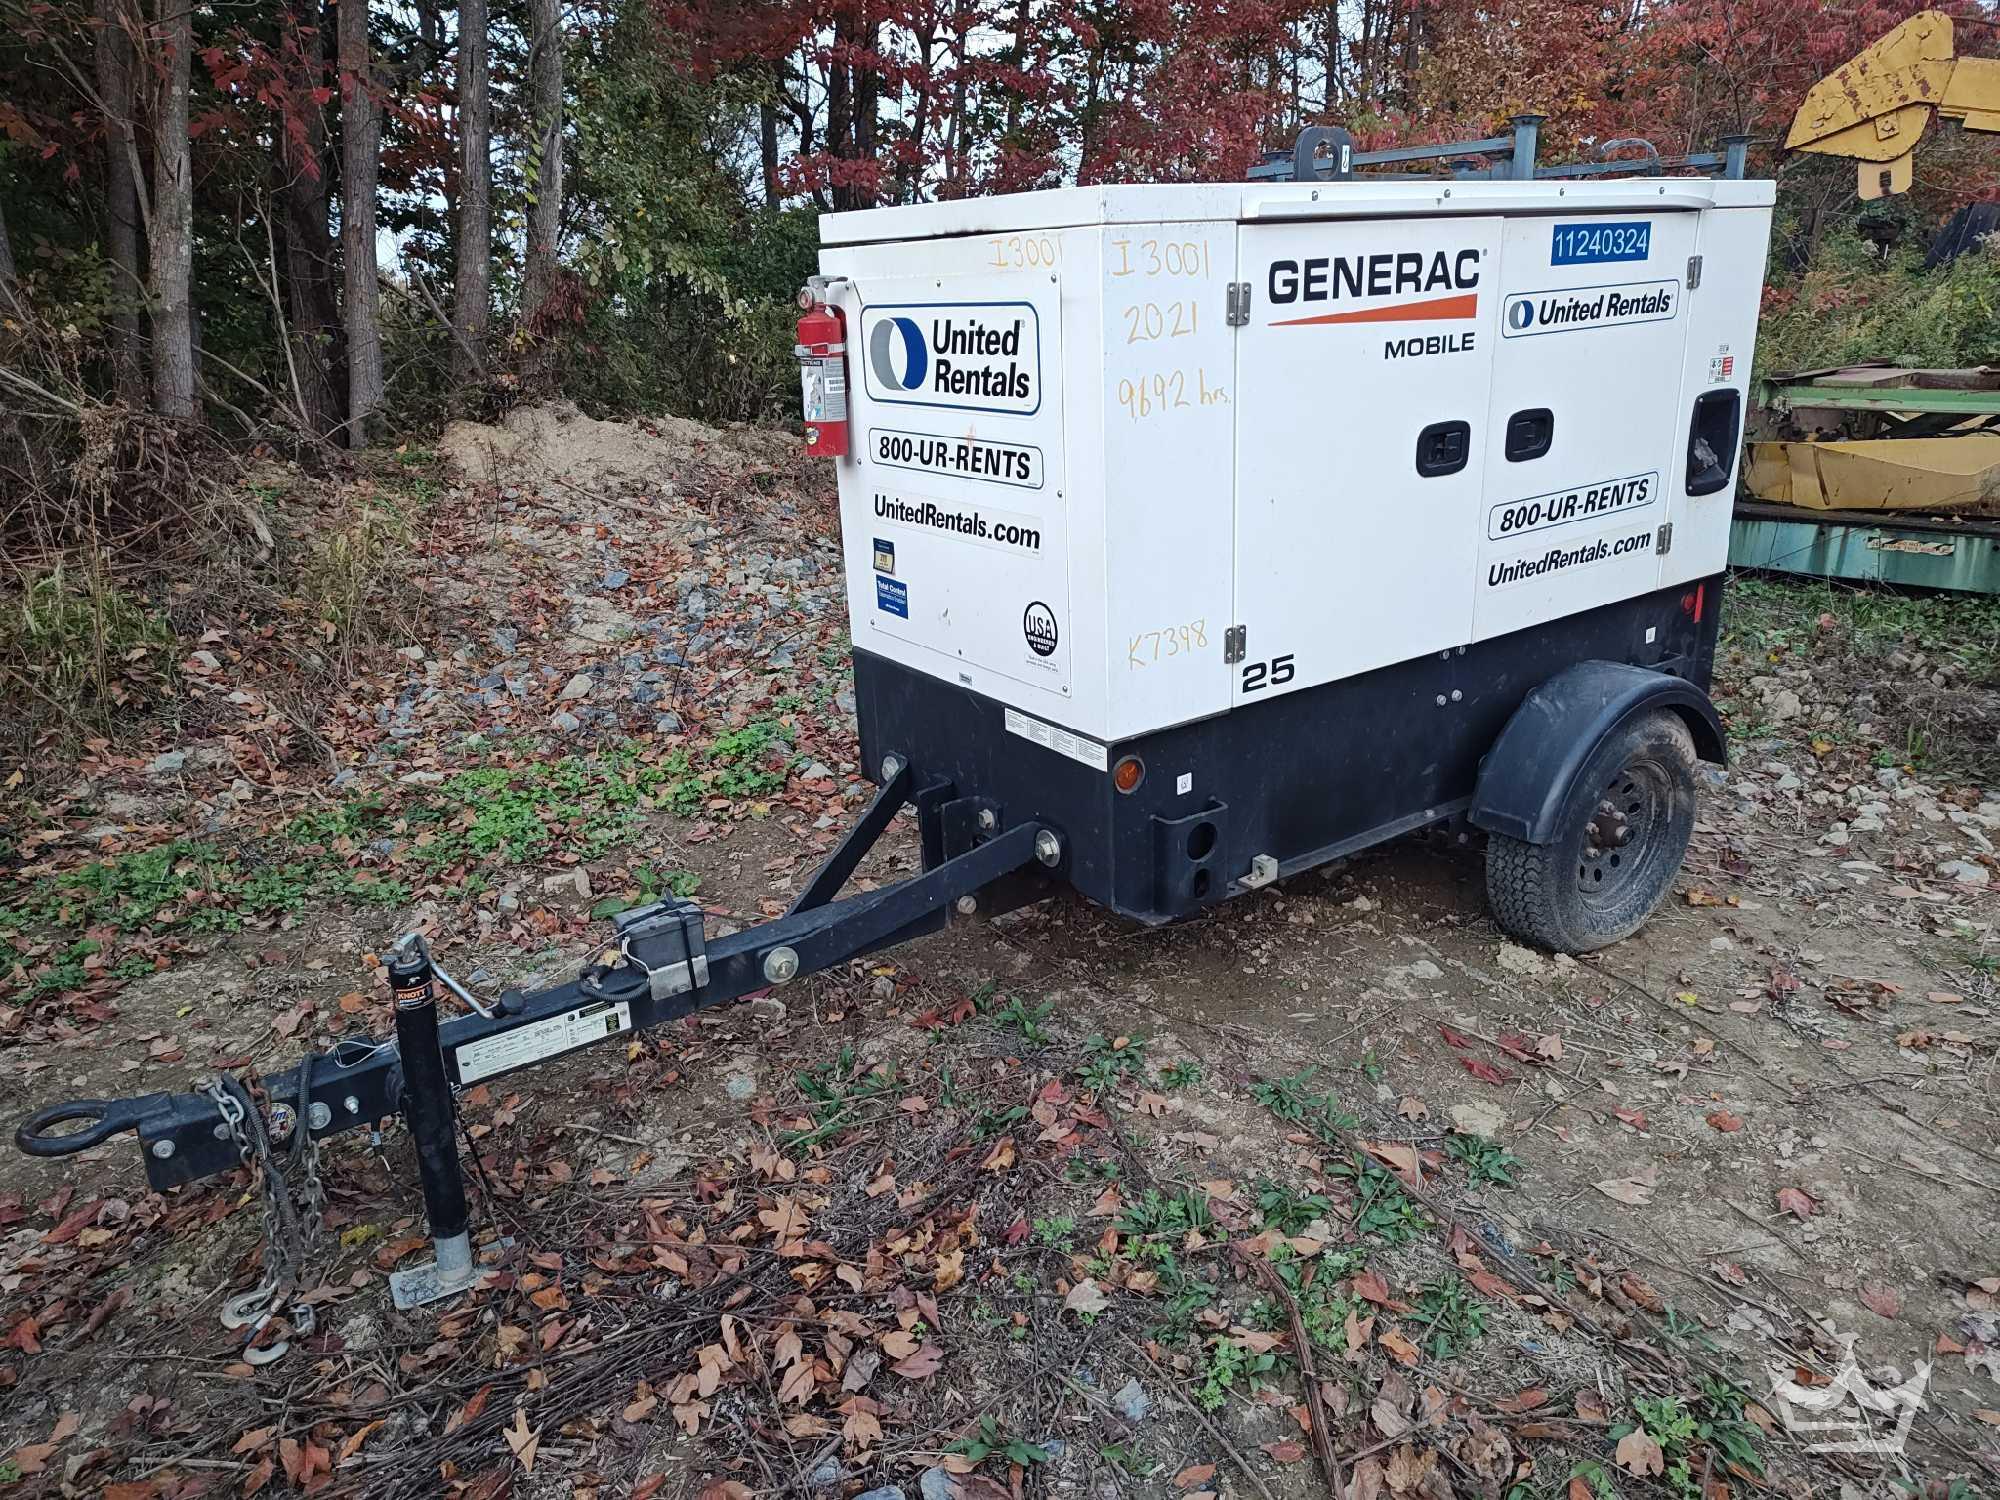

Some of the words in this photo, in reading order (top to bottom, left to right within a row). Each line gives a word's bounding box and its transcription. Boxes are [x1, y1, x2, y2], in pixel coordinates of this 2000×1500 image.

[1555, 228, 1648, 257] 11240324
[1268, 248, 1480, 305] GENERAC
[1124, 301, 1197, 344] 2021
[1538, 294, 1604, 326] United
[1605, 288, 1671, 318] Rentals
[932, 319, 1021, 356] United
[1384, 331, 1476, 360] MOBILE
[934, 358, 1030, 398] Rentals
[879, 436, 1031, 480] 800-UR-RENTS
[874, 493, 1041, 549] UnitedRentals.com
[1500, 478, 1649, 532] 800-UR-RENTS
[1488, 532, 1652, 587] UnitedRentals.com
[1028, 614, 1053, 640] USA
[1242, 653, 1295, 693] 25
[398, 990, 425, 999] KNOTT
